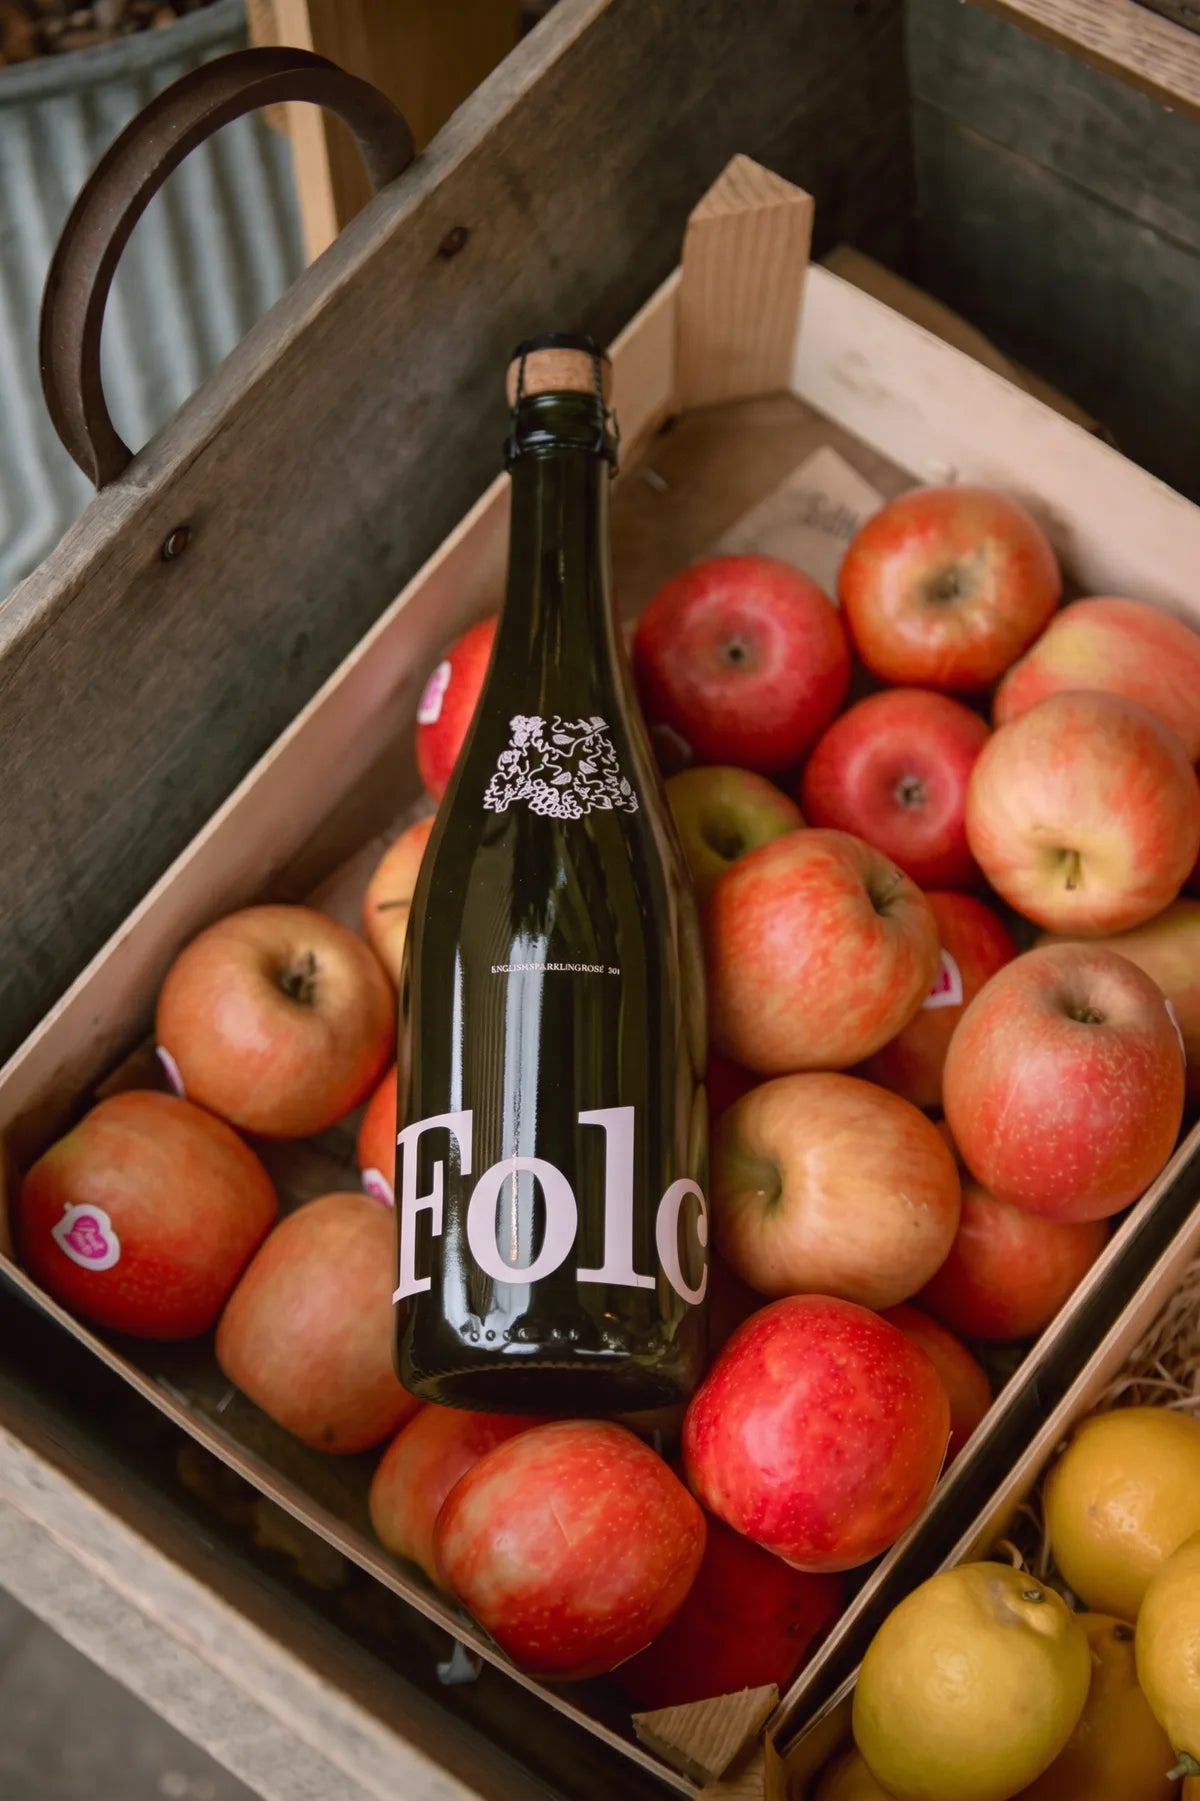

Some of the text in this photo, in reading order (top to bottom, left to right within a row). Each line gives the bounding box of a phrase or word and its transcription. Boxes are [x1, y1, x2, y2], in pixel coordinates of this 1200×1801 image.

[491, 964, 529, 974] ENGLISH
[530, 962, 581, 972] SPARKLING
[392, 1105, 708, 1305] Folc
